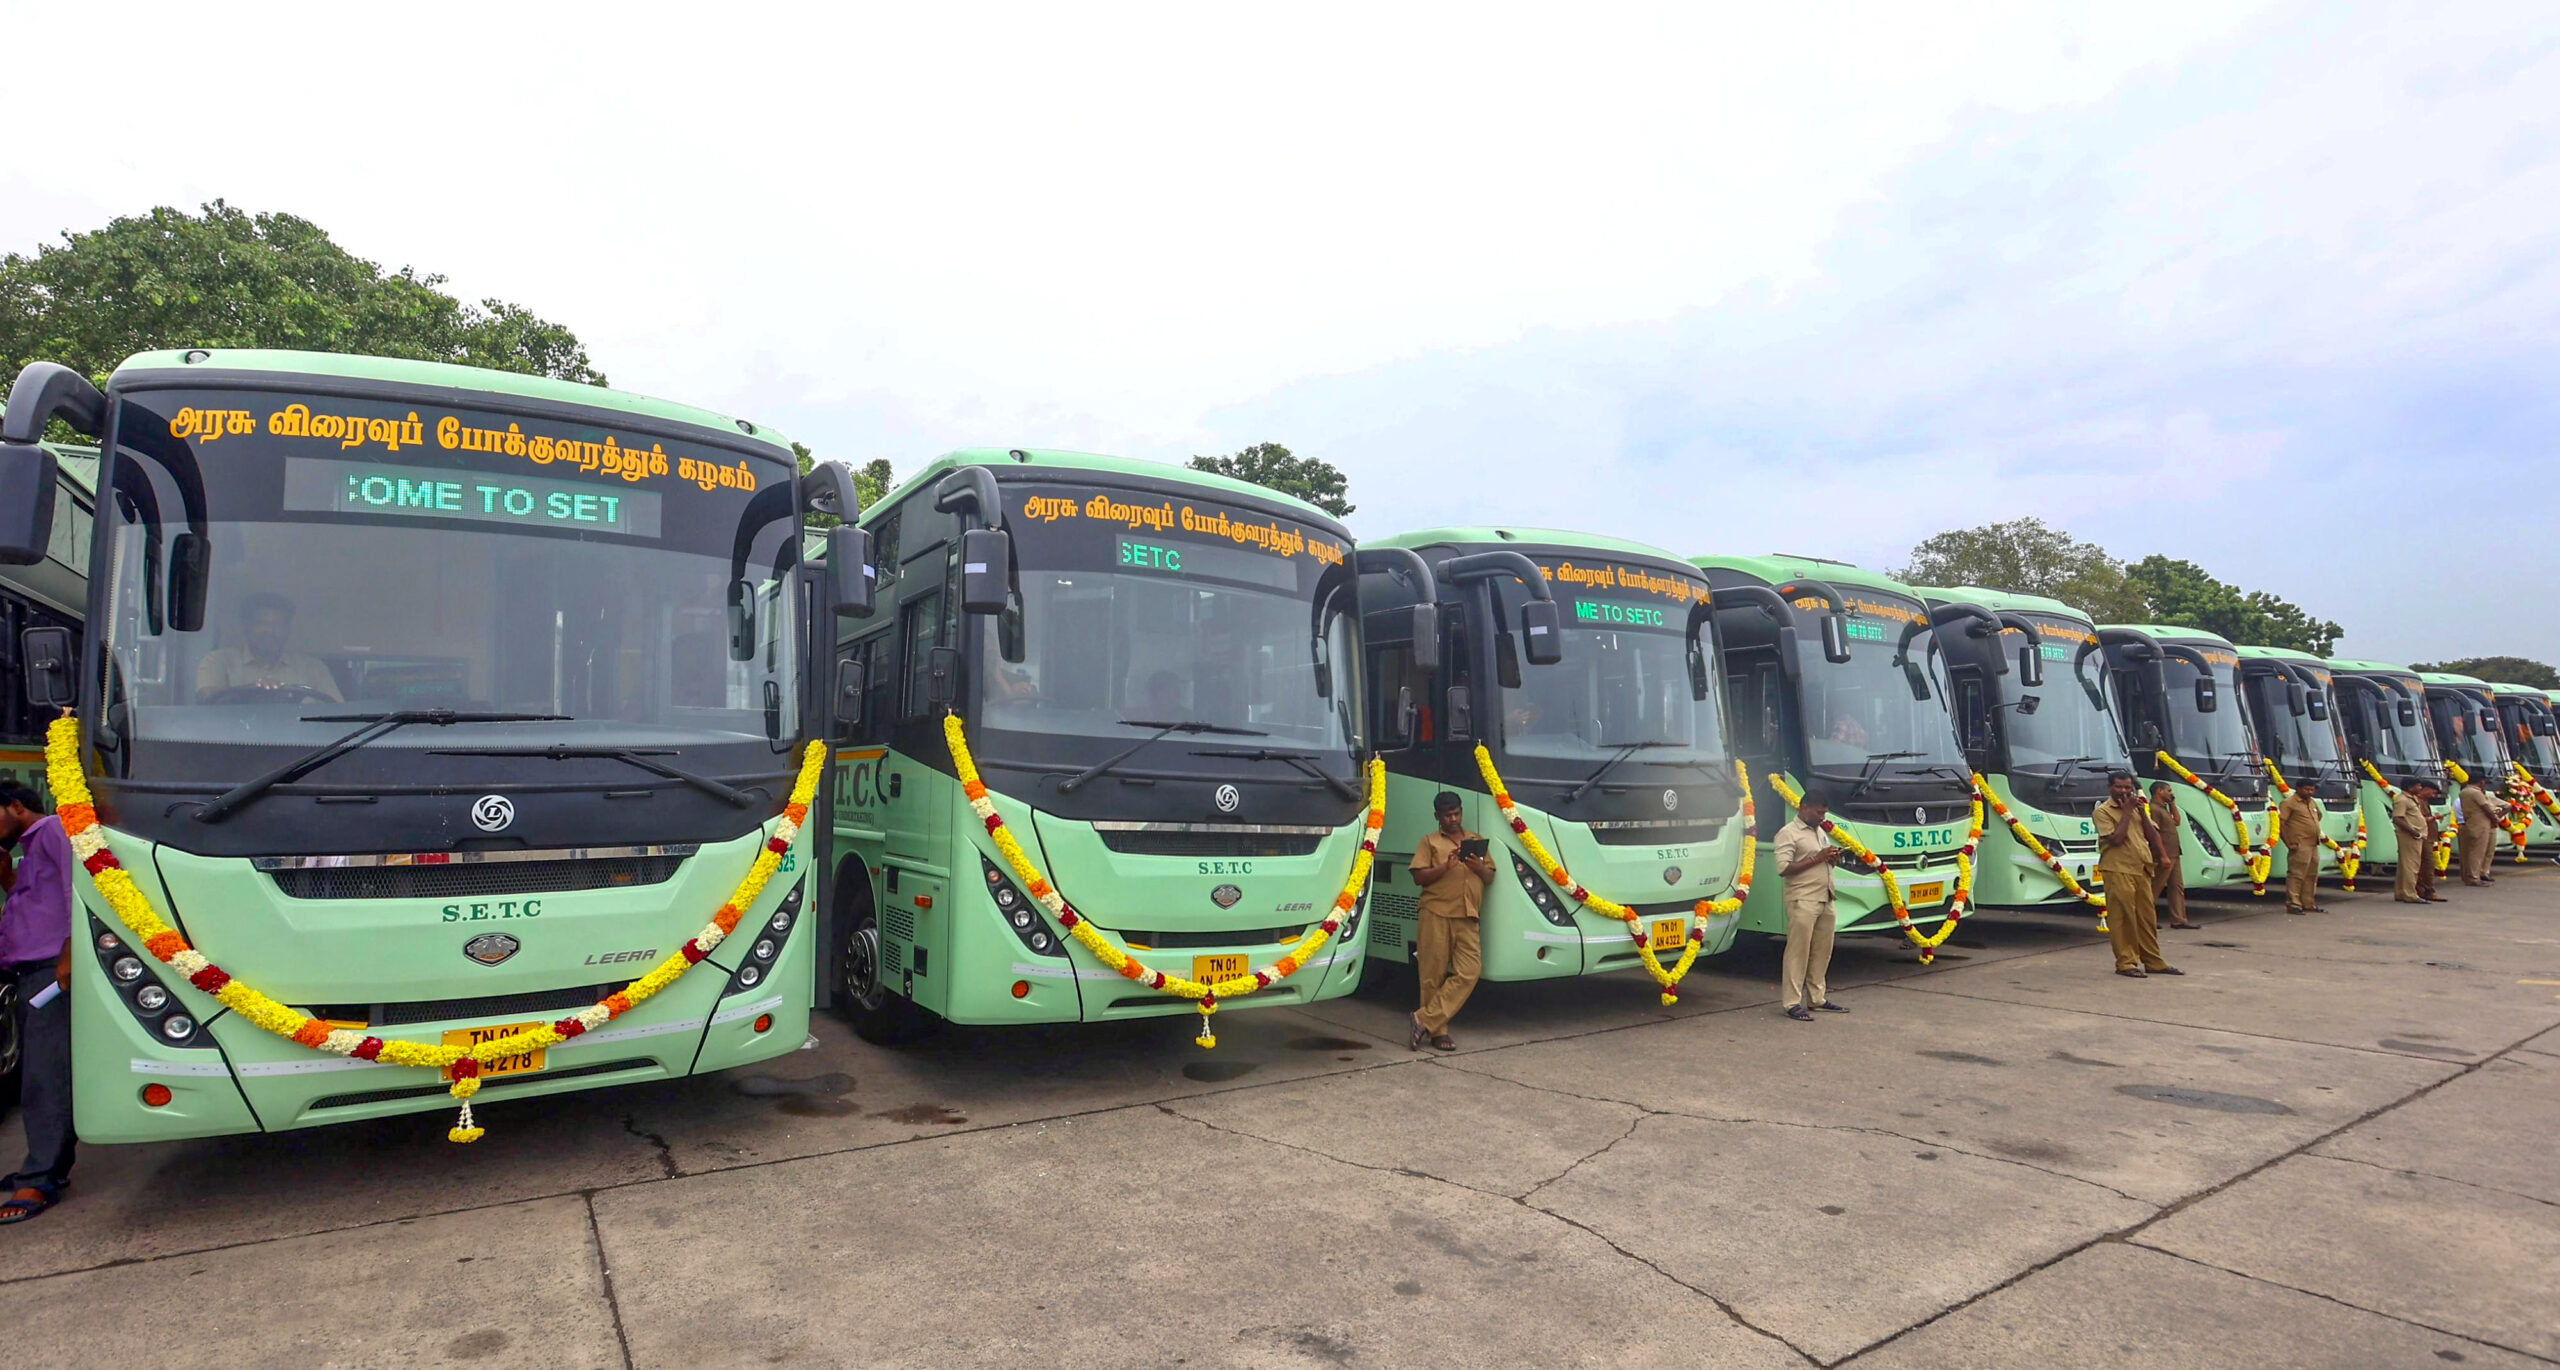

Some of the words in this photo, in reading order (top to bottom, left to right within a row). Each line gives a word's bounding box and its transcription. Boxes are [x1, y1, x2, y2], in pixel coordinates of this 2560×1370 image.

[170, 406, 256, 444] அரசு
[268, 403, 424, 451] விரைவுப்
[437, 416, 669, 482] போக்குவரத்துக்
[678, 456, 756, 492] கழகம்
[349, 474, 463, 511] OME
[476, 484, 536, 516] TO
[547, 491, 620, 523] SET
[1024, 495, 1078, 523] அரசு
[1085, 495, 1175, 531] விரைவுப்
[1181, 506, 1304, 557] போக்குவரத்துக்
[1122, 541, 1181, 571] SETC
[1575, 601, 1599, 620] ME
[1601, 604, 1623, 622] TO
[1627, 607, 1663, 626] SETC
[1893, 829, 1953, 849] S.E.T.C
[1657, 848, 1689, 860] S.E.T.C
[1198, 861, 1253, 875] S.E.T.C
[441, 900, 542, 923] S.E.T.C
[1661, 923, 1670, 933] TN
[1670, 922, 1678, 932] 01
[1656, 936, 1665, 947] AN
[1210, 959, 1223, 972] TN
[1226, 957, 1237, 971] 01
[470, 1029, 495, 1046] TN
[484, 1051, 532, 1073] 4278
